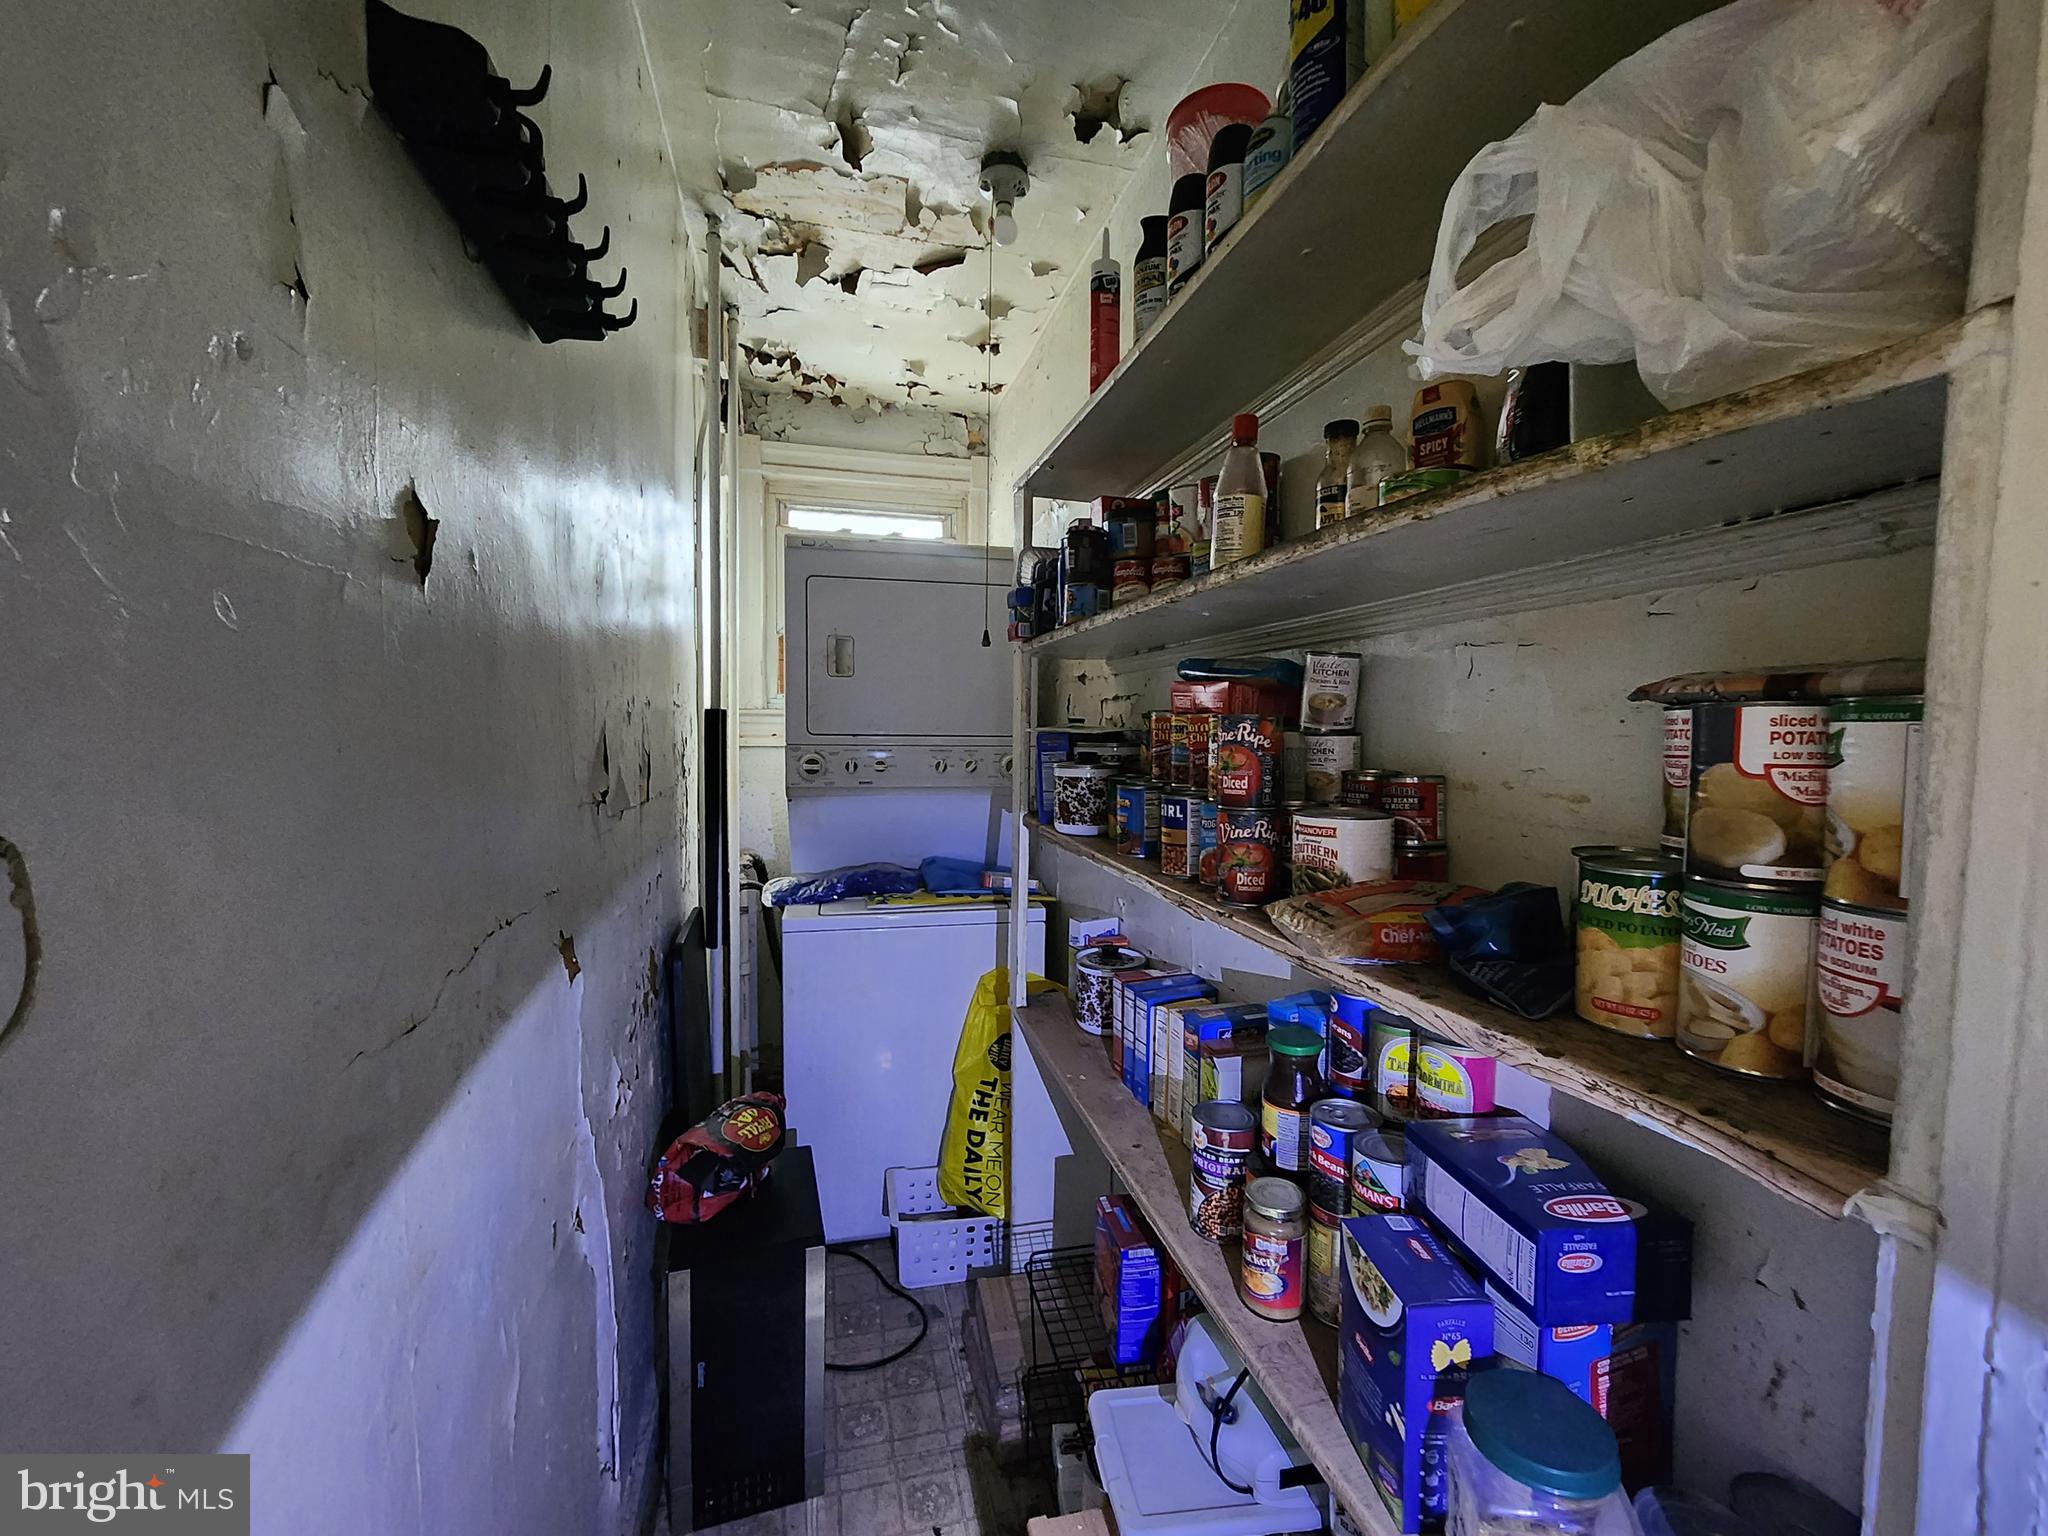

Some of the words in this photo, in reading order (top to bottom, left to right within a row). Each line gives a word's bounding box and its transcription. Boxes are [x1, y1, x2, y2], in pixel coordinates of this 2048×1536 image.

[1419, 436, 1449, 457] SPICY
[1312, 668, 1350, 678] KITCHEN
[1769, 714, 1817, 729] sliced
[1237, 721, 1272, 749] Ripe
[1773, 752, 1804, 760] LOW
[1222, 775, 1249, 790] Diced
[1219, 822, 1253, 844] Vine
[1236, 872, 1266, 887] Diced
[1690, 916, 1738, 939] Maid
[1841, 923, 1886, 942] white
[1830, 956, 1878, 976] SODIUM
[969, 1077, 999, 1124] THE
[992, 1081, 1012, 1134] WEAR
[962, 1127, 987, 1205] DAILY
[1317, 1153, 1350, 1178] Beans
[1528, 1183, 1607, 1194] FARFALLE
[1553, 1200, 1623, 1218] Barilla
[1563, 1242, 1598, 1251] FARFALLE
[1528, 1244, 1536, 1278] Nutrition
[1527, 1279, 1535, 1303] Facts
